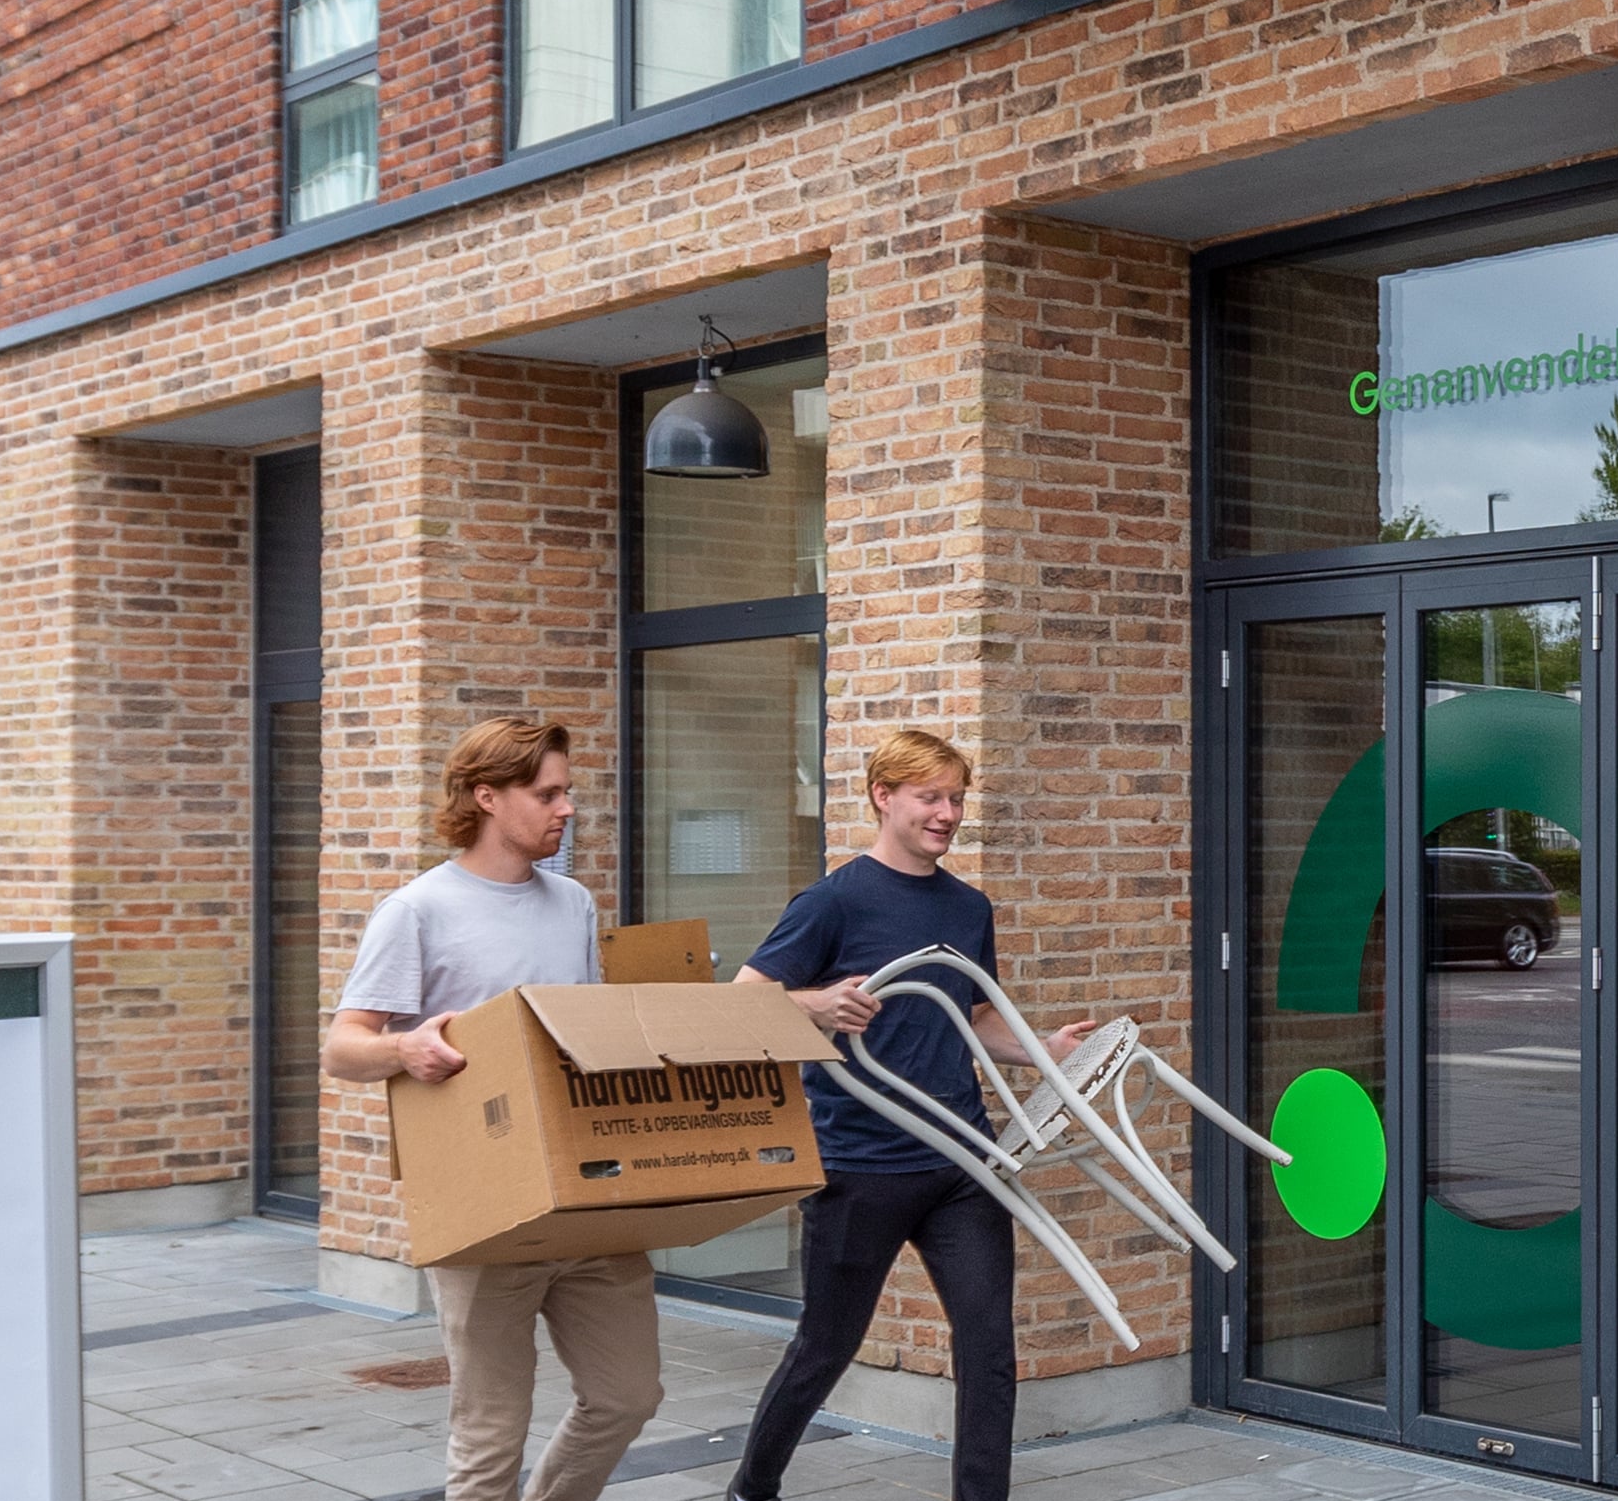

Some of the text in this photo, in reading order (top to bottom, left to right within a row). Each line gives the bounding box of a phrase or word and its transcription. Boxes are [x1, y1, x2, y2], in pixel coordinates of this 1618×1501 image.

[677, 1062, 786, 1111] nyborg
[592, 1110, 773, 1137] FLYTTE- & OPBEVARINGSKASSE
[631, 1147, 751, 1171] www.harald-nyborg.dk
